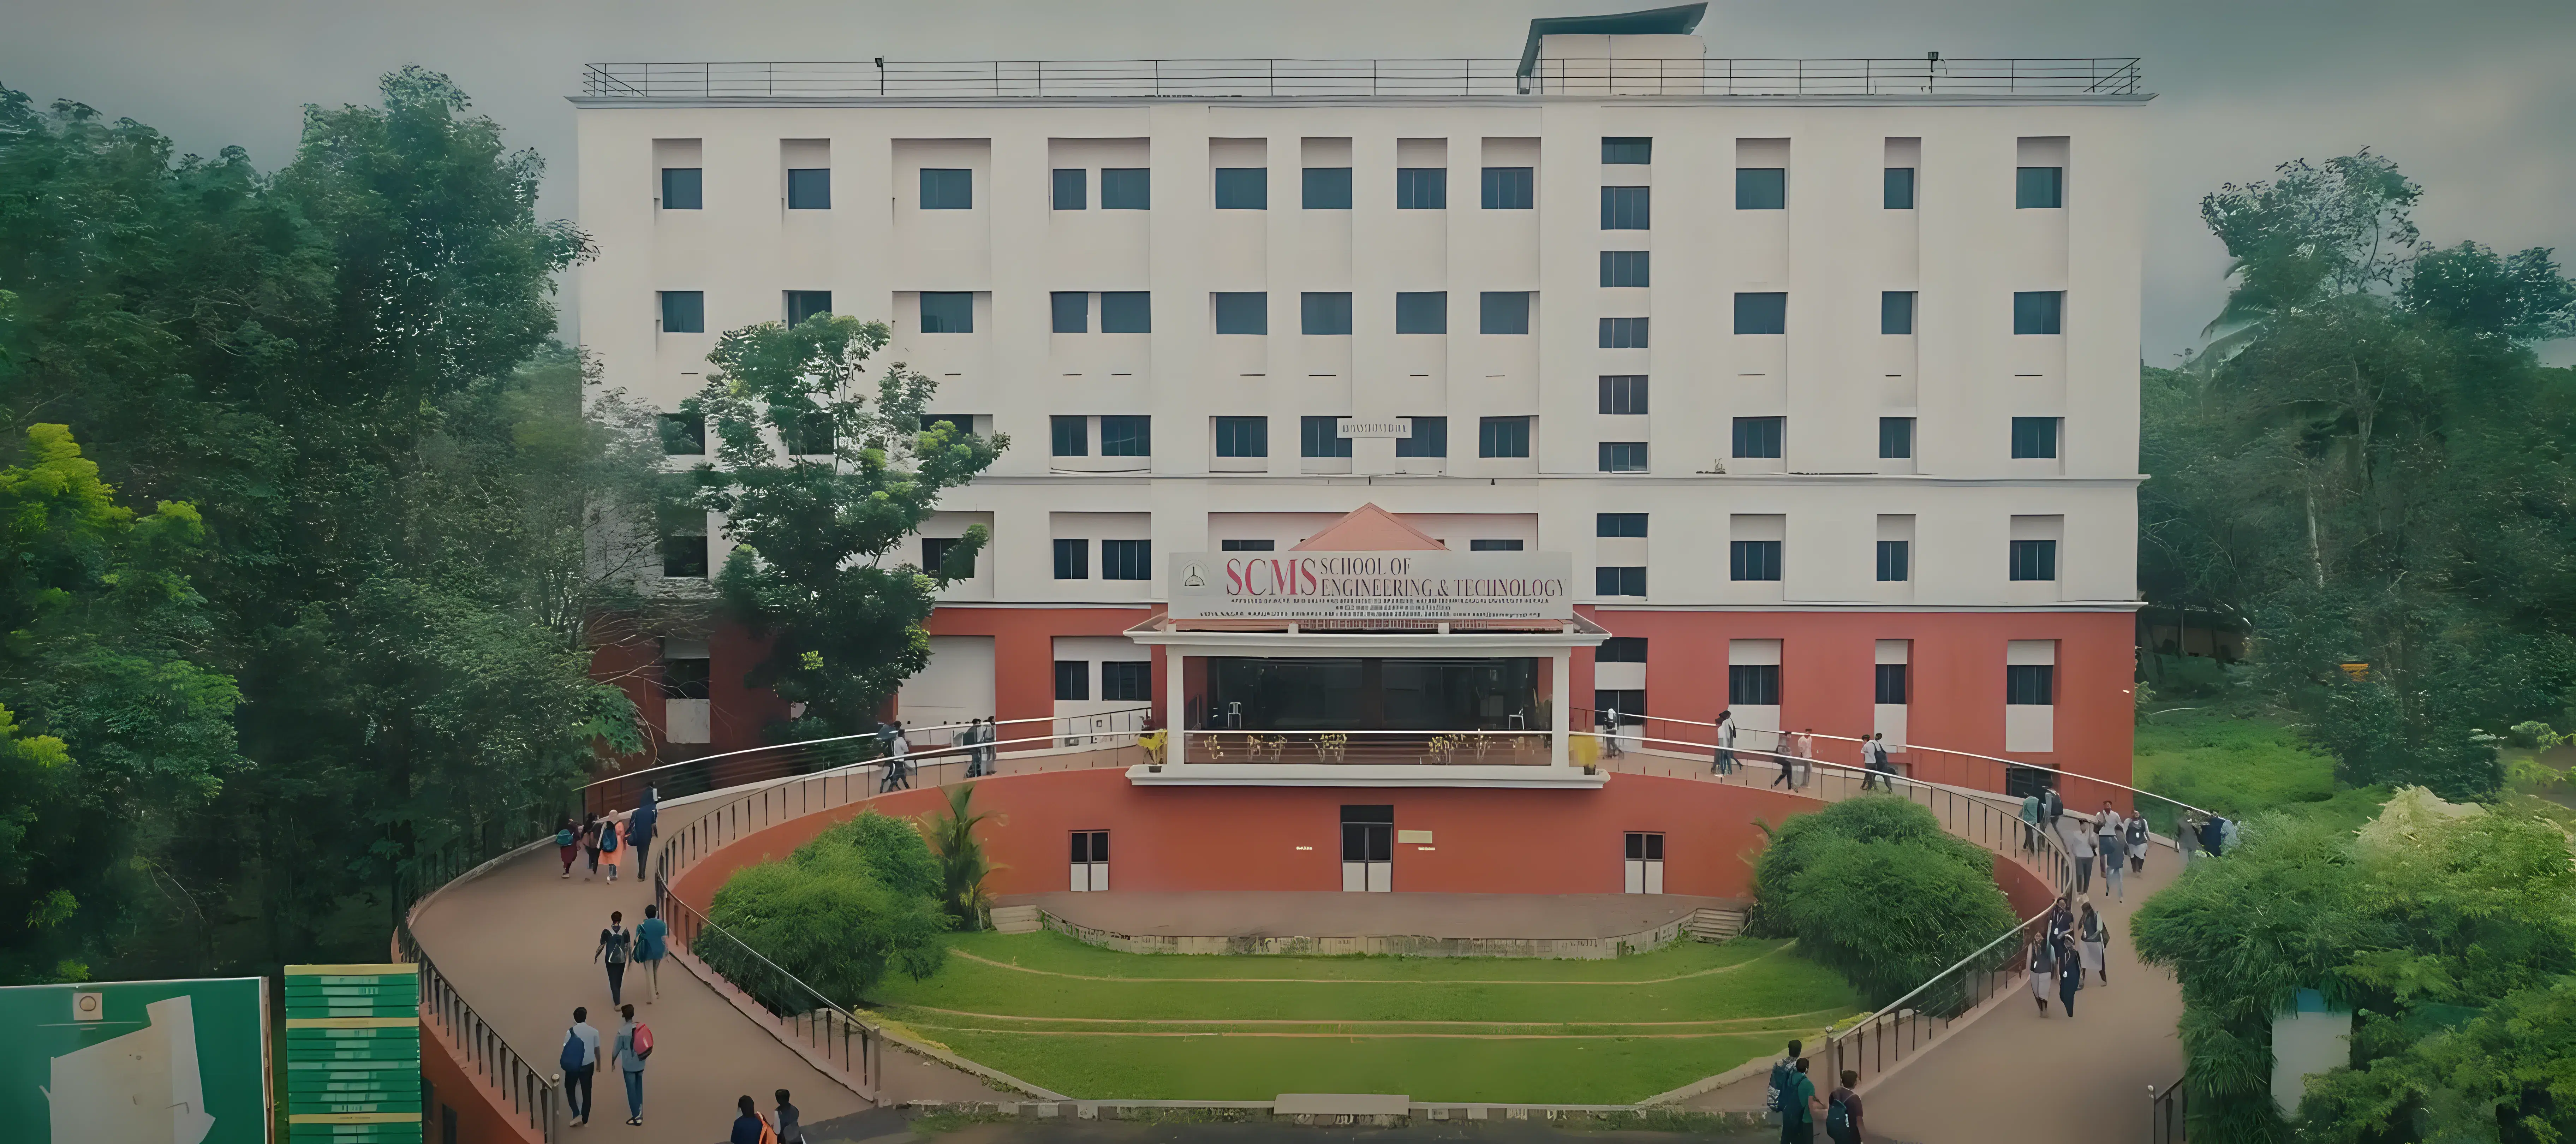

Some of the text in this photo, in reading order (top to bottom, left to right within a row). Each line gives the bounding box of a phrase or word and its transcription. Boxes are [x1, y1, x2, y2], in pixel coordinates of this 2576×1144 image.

[1320, 558, 1411, 575] SCHOOL OF
[1227, 558, 1317, 596] SCMS
[1321, 579, 1566, 597] ENGINEERING & TECHNOLOGY
